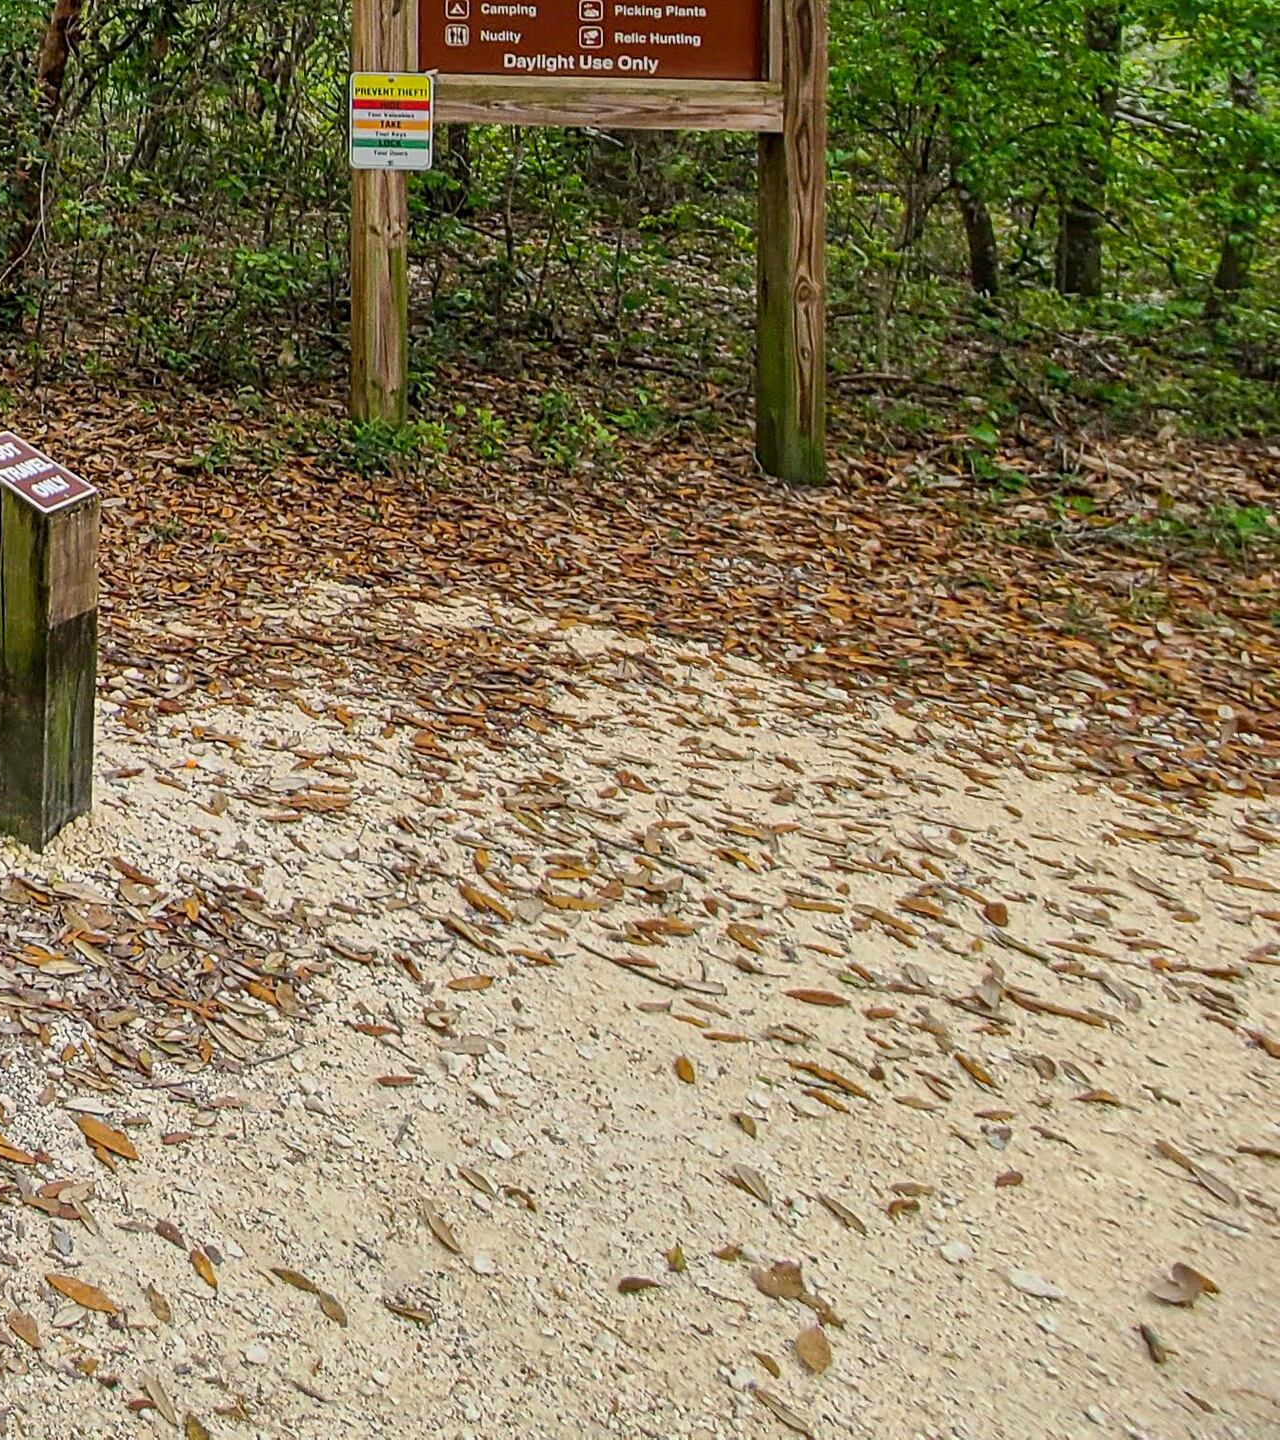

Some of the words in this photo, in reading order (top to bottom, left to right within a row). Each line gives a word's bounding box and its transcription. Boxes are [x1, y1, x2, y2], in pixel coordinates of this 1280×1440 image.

[481, 3, 536, 17] Camping
[615, 5, 662, 18] Picking
[666, 6, 706, 17] Plants
[481, 30, 521, 43] Nudity
[615, 32, 646, 43] Relic
[650, 33, 701, 46] Hunting
[504, 54, 574, 72] Daylight
[580, 55, 613, 69] Use
[621, 57, 659, 73] Only
[355, 87, 394, 96] PREVENT
[398, 89, 427, 97] THEFT!
[380, 120, 402, 129] TAKE
[379, 139, 402, 148] LOCK
[31, 474, 70, 497] ONLY
